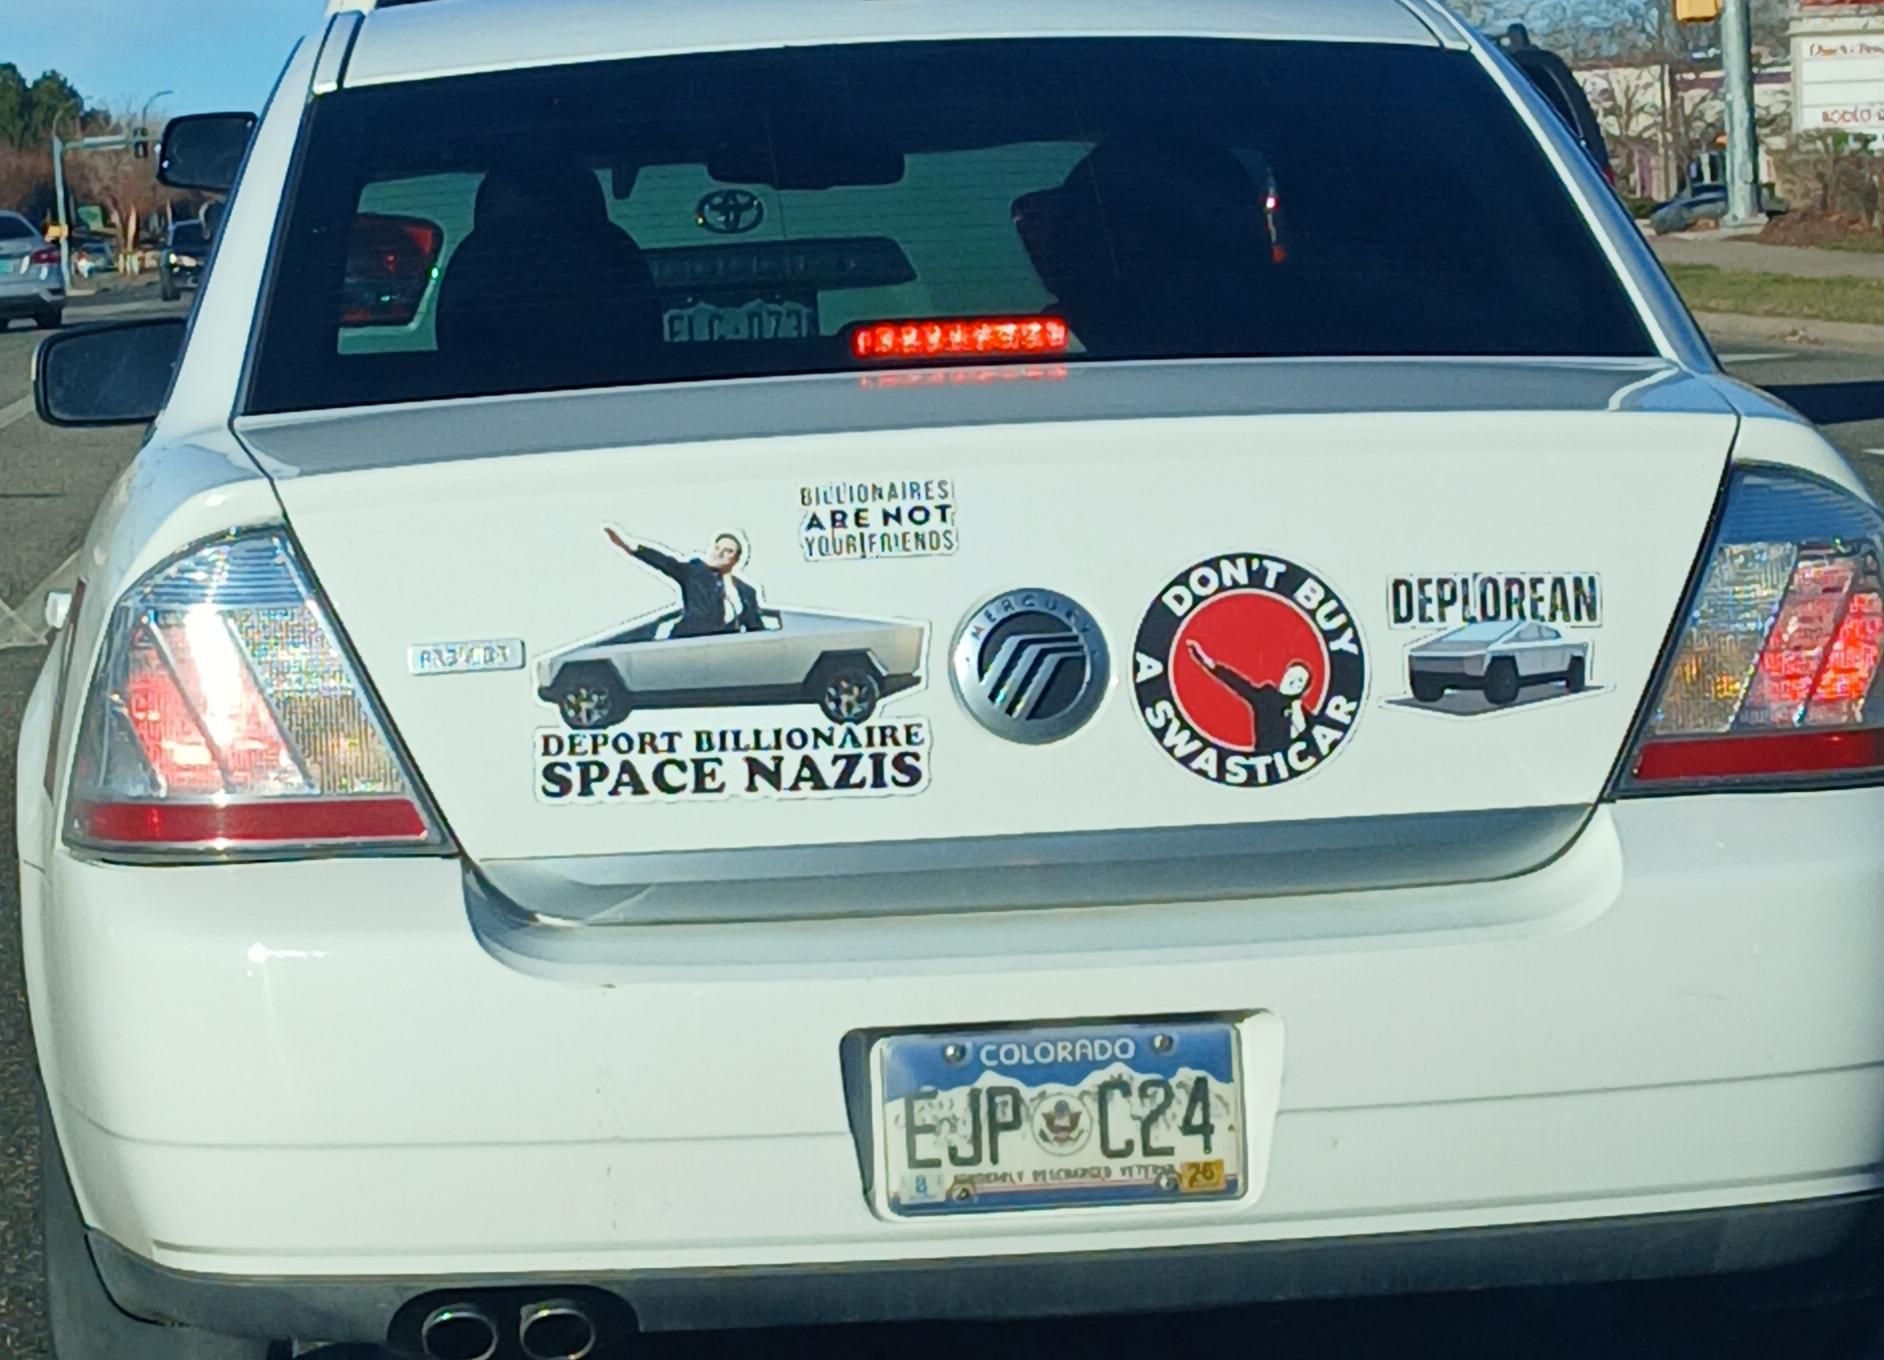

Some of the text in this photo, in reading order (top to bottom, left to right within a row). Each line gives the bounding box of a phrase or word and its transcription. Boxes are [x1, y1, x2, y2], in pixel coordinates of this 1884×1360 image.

[800, 480, 949, 507] BILLIONAIRES
[805, 504, 952, 531] ARE NOT
[804, 530, 954, 557] YOUR FRIENDS
[1161, 557, 1359, 655] DON'T BUY
[1392, 575, 1598, 625] DEPLOREAN
[1135, 651, 1358, 784] A SWASTICAR
[541, 723, 925, 757] DEPORT BILLIONAIRE
[541, 751, 923, 799] SPACE NAZIS
[979, 1038, 1136, 1066] COLORADO
[904, 1076, 1216, 1169] EJP C24
